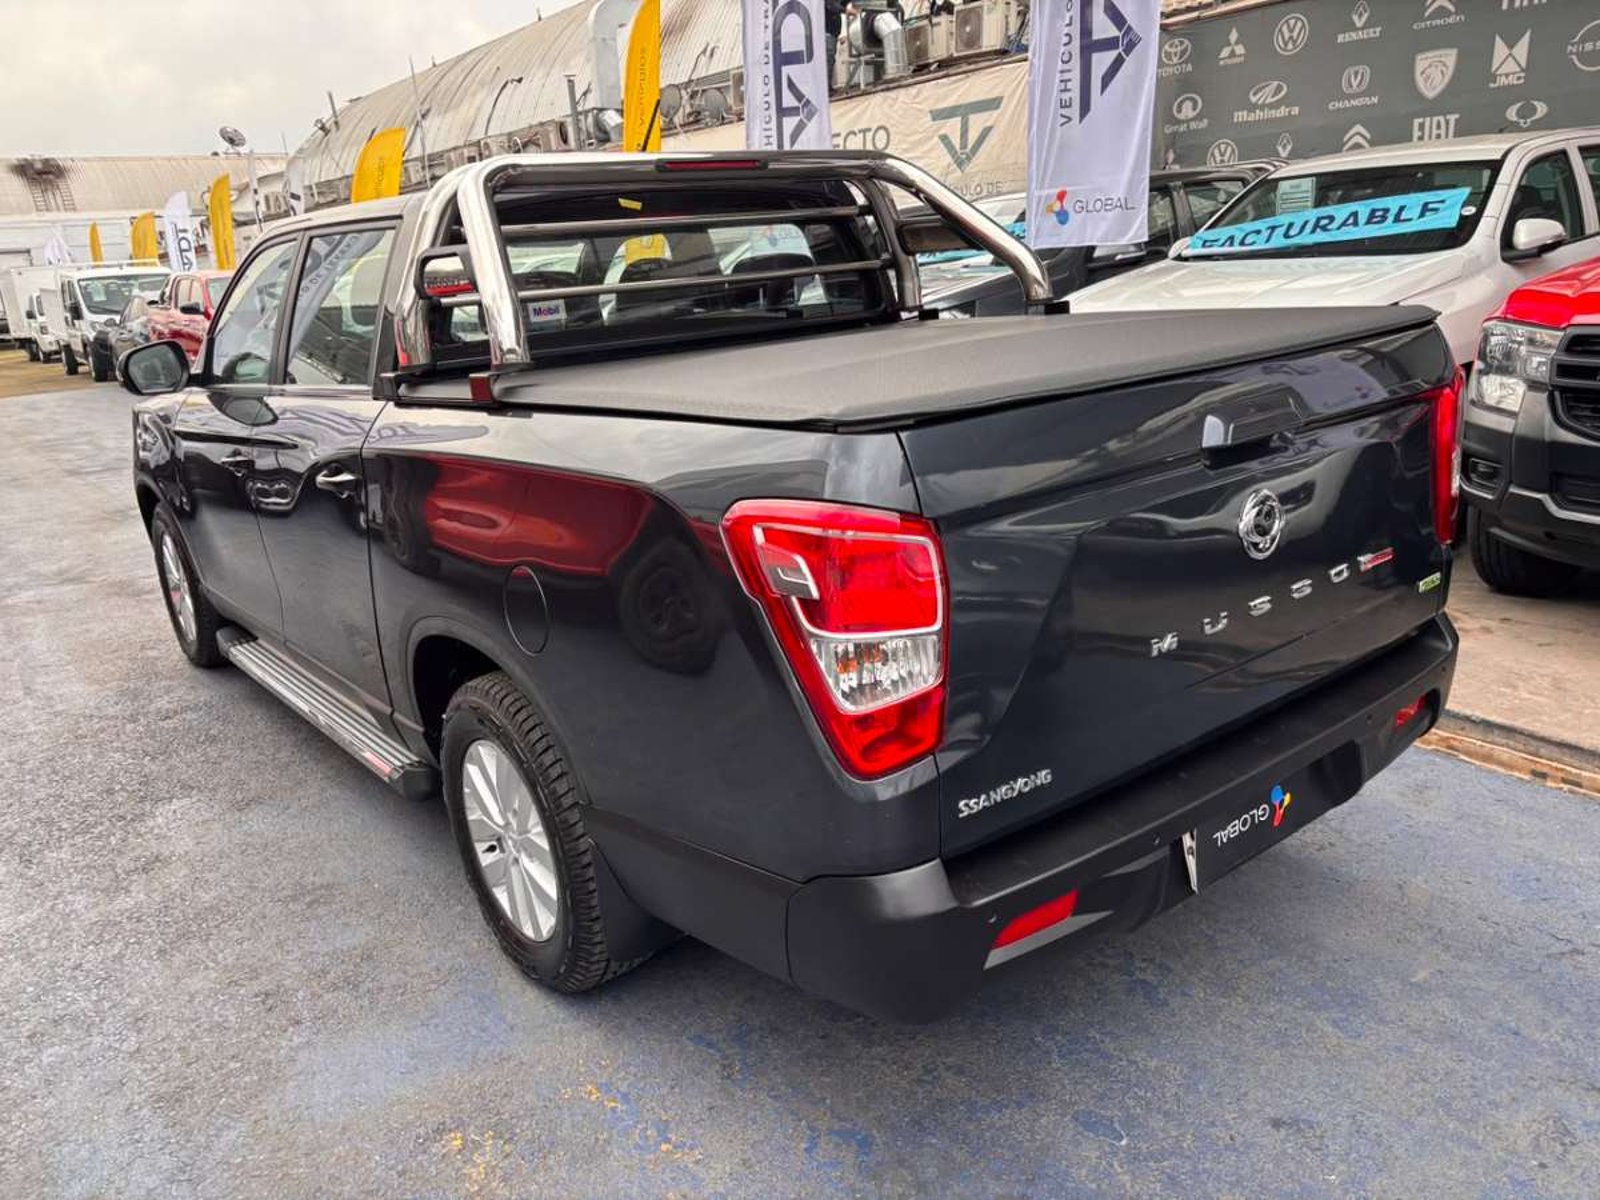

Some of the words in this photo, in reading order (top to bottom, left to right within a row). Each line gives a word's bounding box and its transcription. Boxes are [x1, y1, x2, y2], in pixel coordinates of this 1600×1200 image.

[1337, 26, 1382, 43] RENAULT
[1158, 63, 1193, 78] TOYOTA
[1489, 72, 1526, 88] JMC
[1328, 95, 1379, 110] CHANGAN
[1233, 104, 1299, 123] Mahindra
[1164, 122, 1188, 134] Great
[1189, 118, 1209, 130] Wall
[1412, 113, 1460, 142] FIAT
[1073, 197, 1136, 214] GLOBAL
[533, 304, 560, 317] Mobil
[1149, 563, 1351, 657] MUSSO
[957, 768, 1053, 819] SSANGYONG
[1212, 803, 1270, 847] GLOBAL
